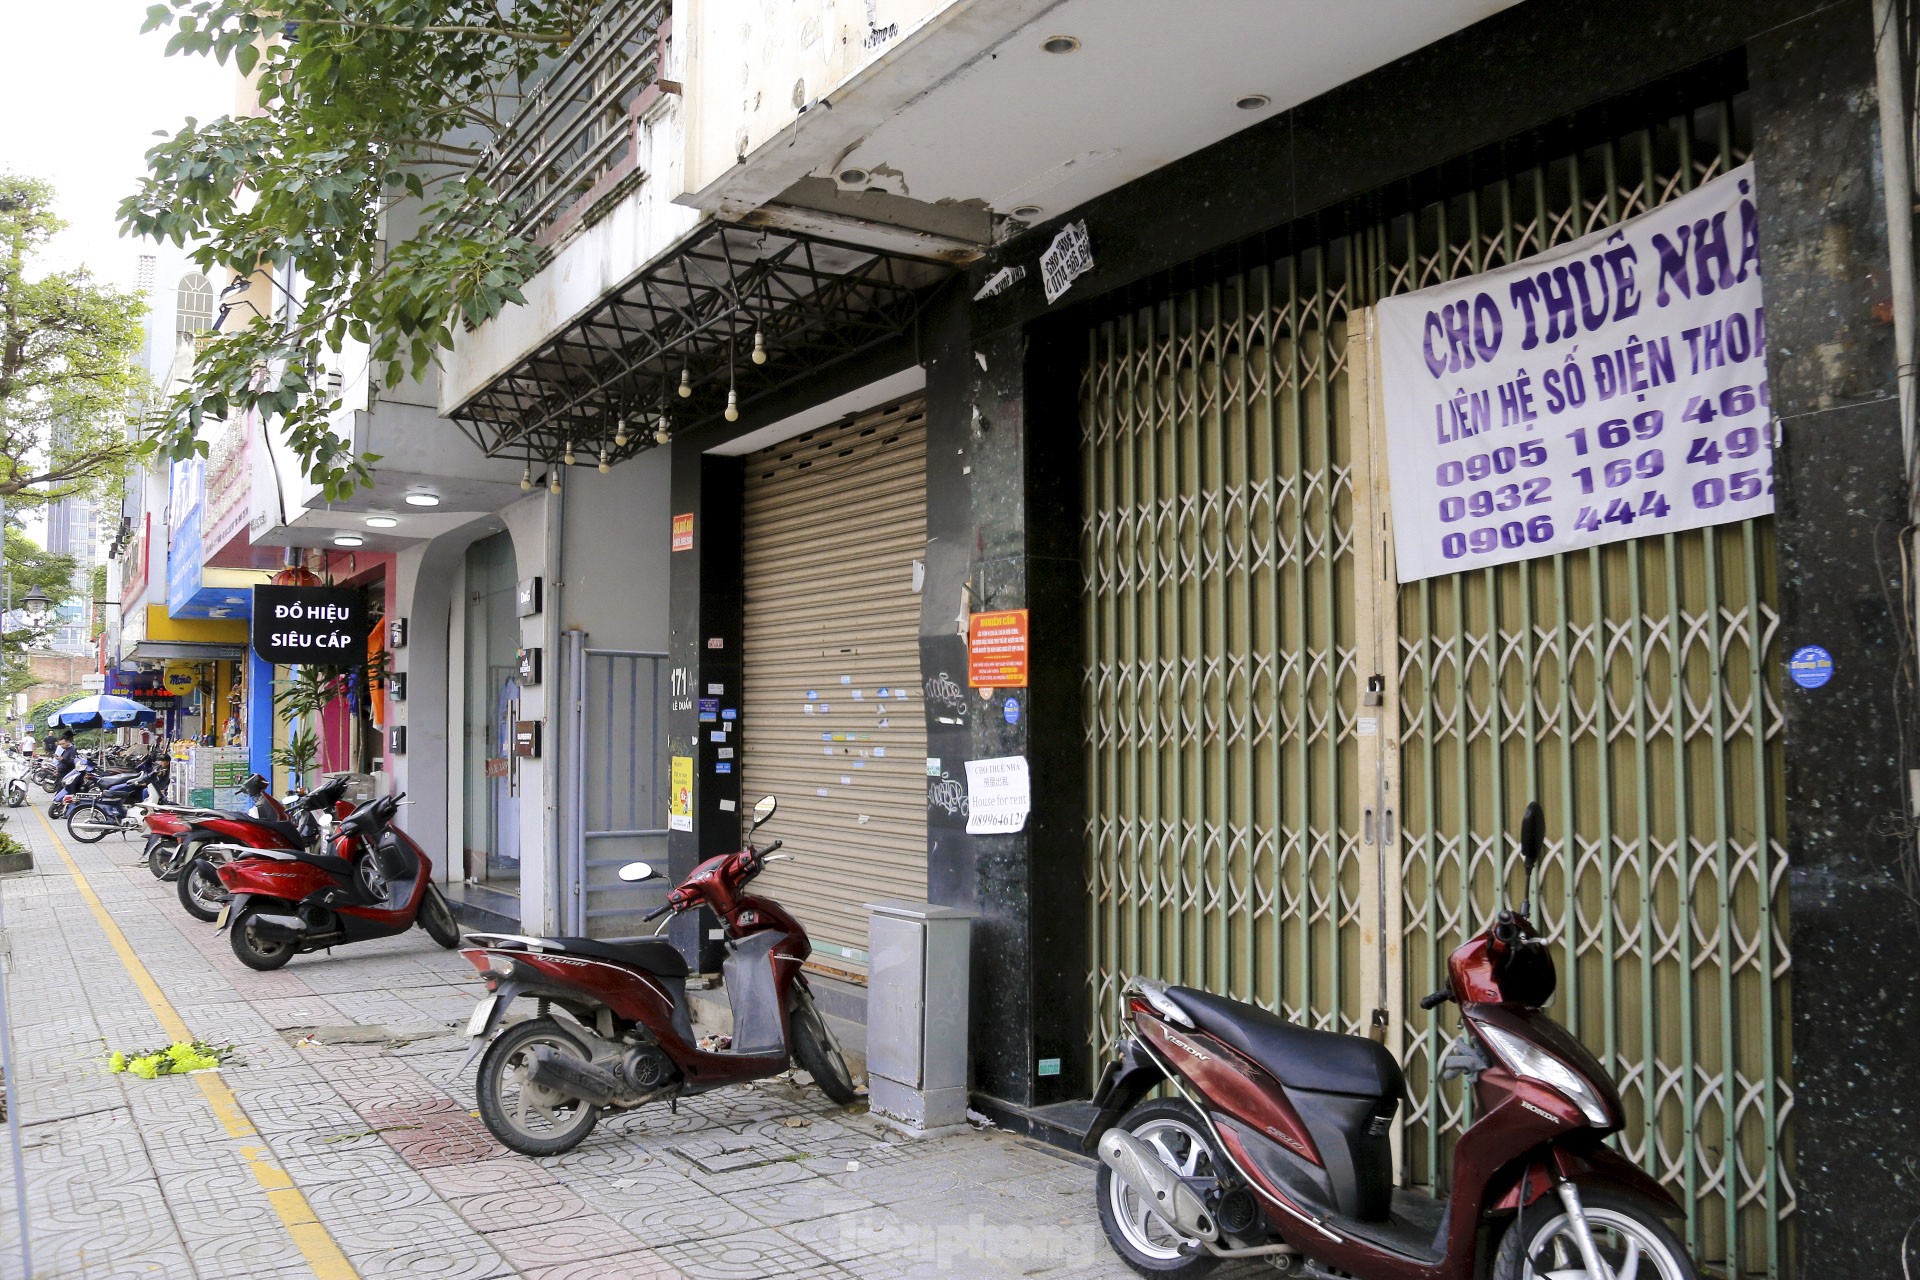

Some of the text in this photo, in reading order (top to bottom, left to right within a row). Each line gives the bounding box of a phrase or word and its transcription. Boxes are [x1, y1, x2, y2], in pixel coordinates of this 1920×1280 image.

[1423, 293, 1503, 379] CHO
[1510, 229, 1642, 351] THUÊ
[1435, 387, 1491, 445] LIÊN
[1497, 368, 1537, 431] HỆ
[1543, 345, 1586, 414] SỐ
[1592, 335, 1676, 402] ĐIỆN
[1436, 380, 1768, 487] 0905 169 46
[1438, 422, 1771, 523] 0932 169 49
[1441, 466, 1774, 560] 0906 444 05
[274, 600, 349, 623] ĐỒ HIỆU
[271, 629, 351, 648] SIÊU CẤP
[671, 667, 687, 697] 171
[972, 794, 1027, 807] House for rent
[537, 955, 589, 967] VISION
[1160, 1024, 1212, 1062] VISION
[1521, 1100, 1561, 1125] HONDA
